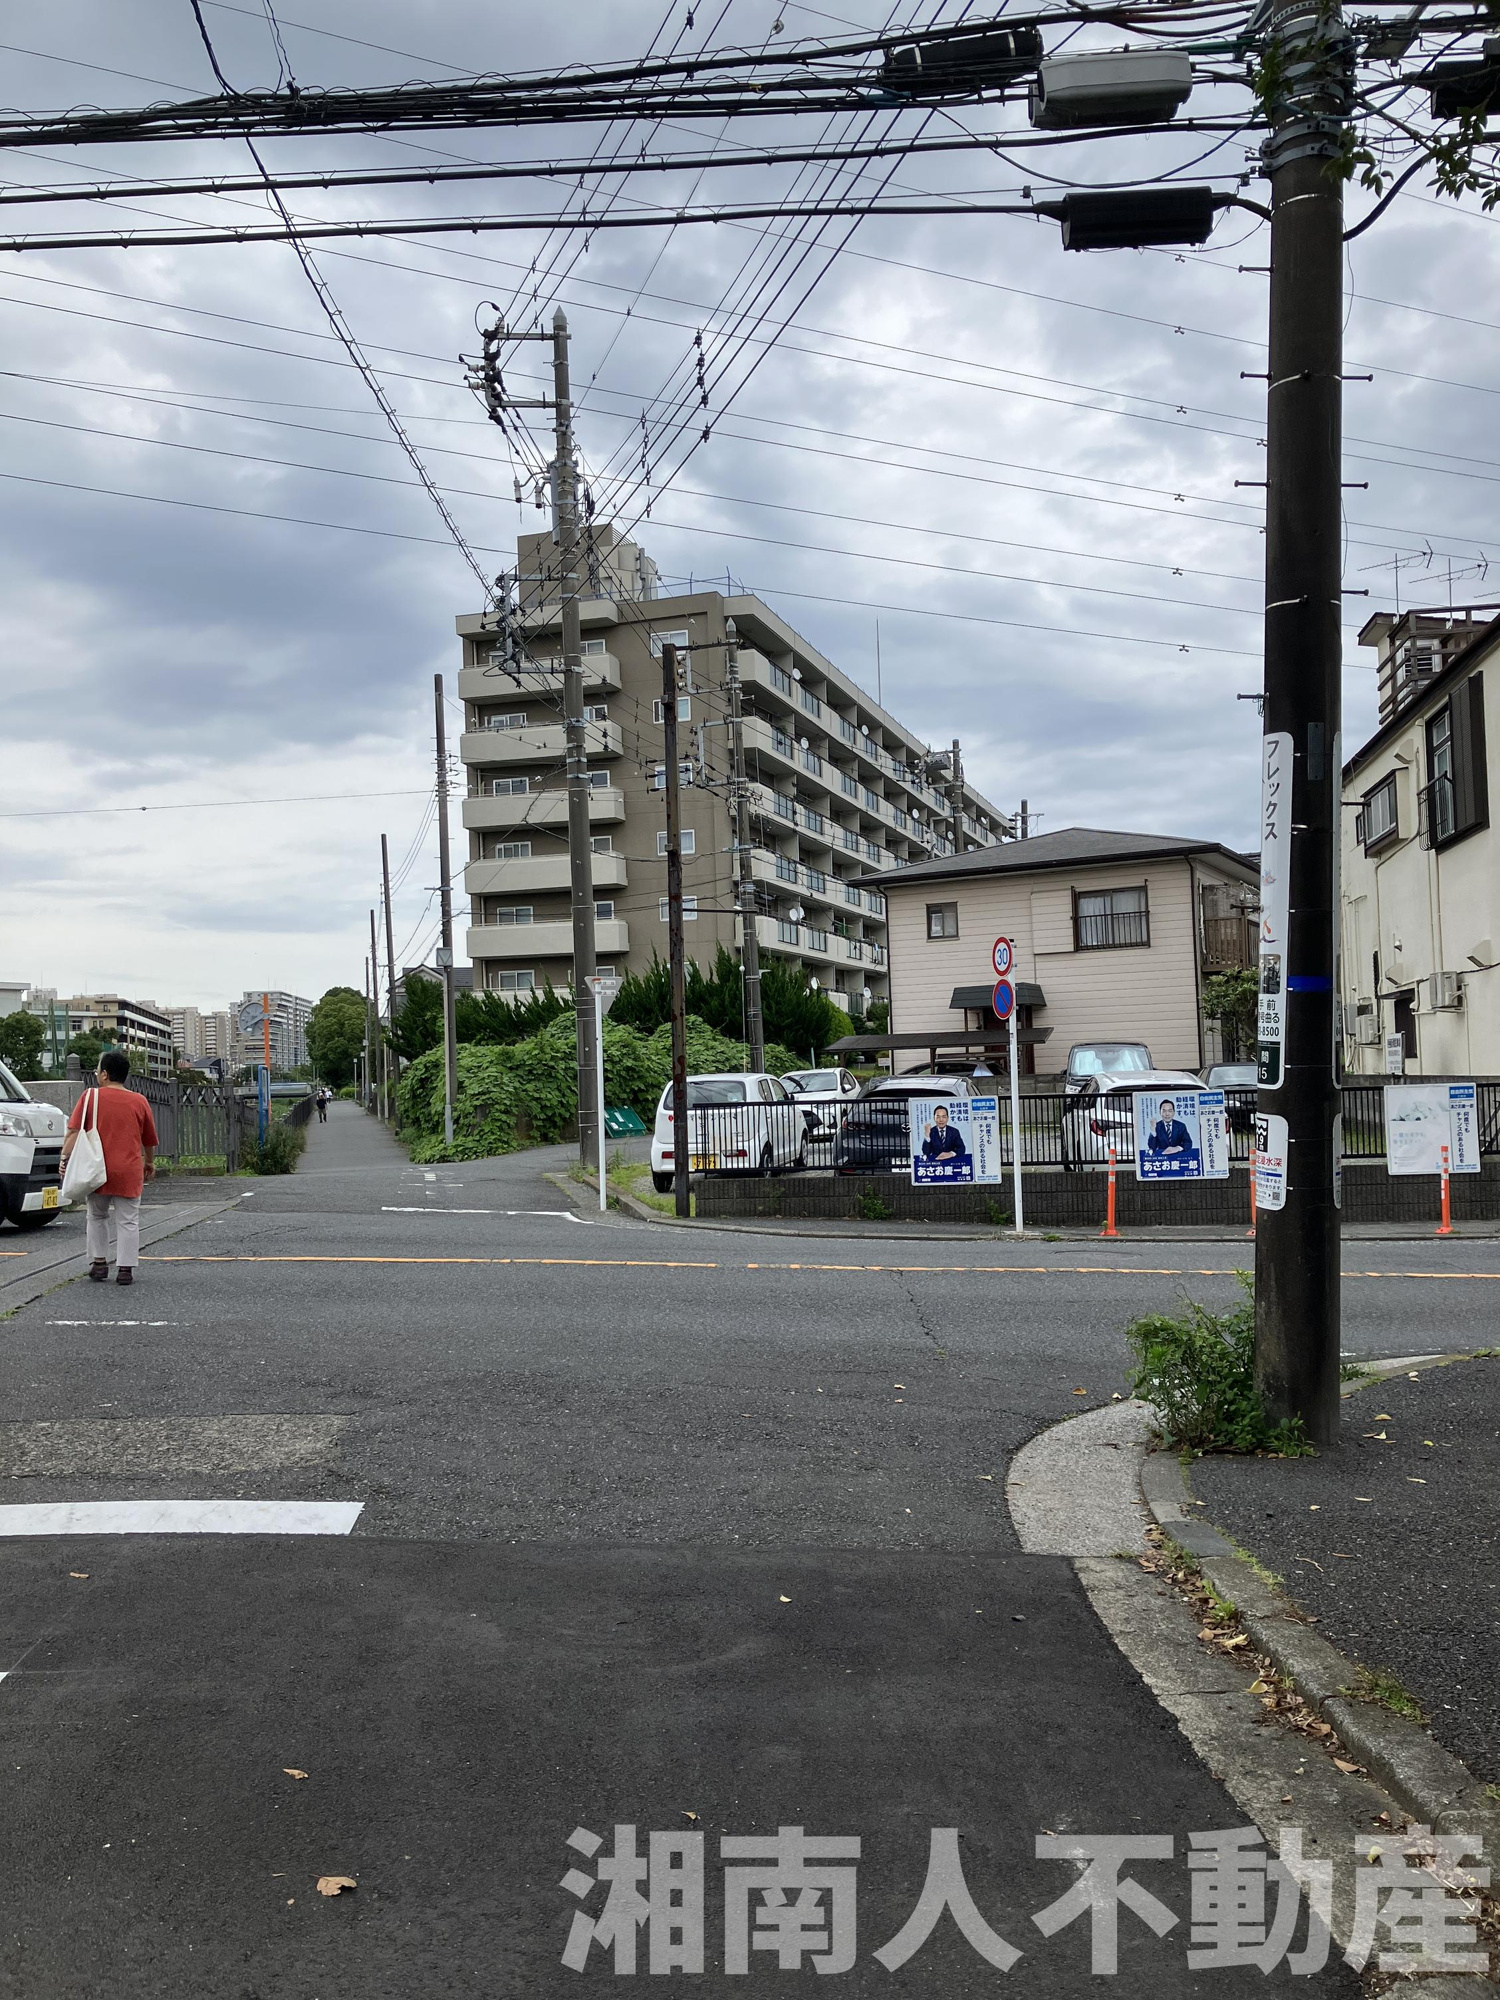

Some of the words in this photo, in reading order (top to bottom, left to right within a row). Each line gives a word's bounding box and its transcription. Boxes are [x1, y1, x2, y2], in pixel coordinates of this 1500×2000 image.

[1264, 740, 1280, 841] フレックス
[997, 948, 1008, 966] 30
[917, 1165, 971, 1177] あさお慶一郎
[1143, 1160, 1198, 1171] あさお慶一郎
